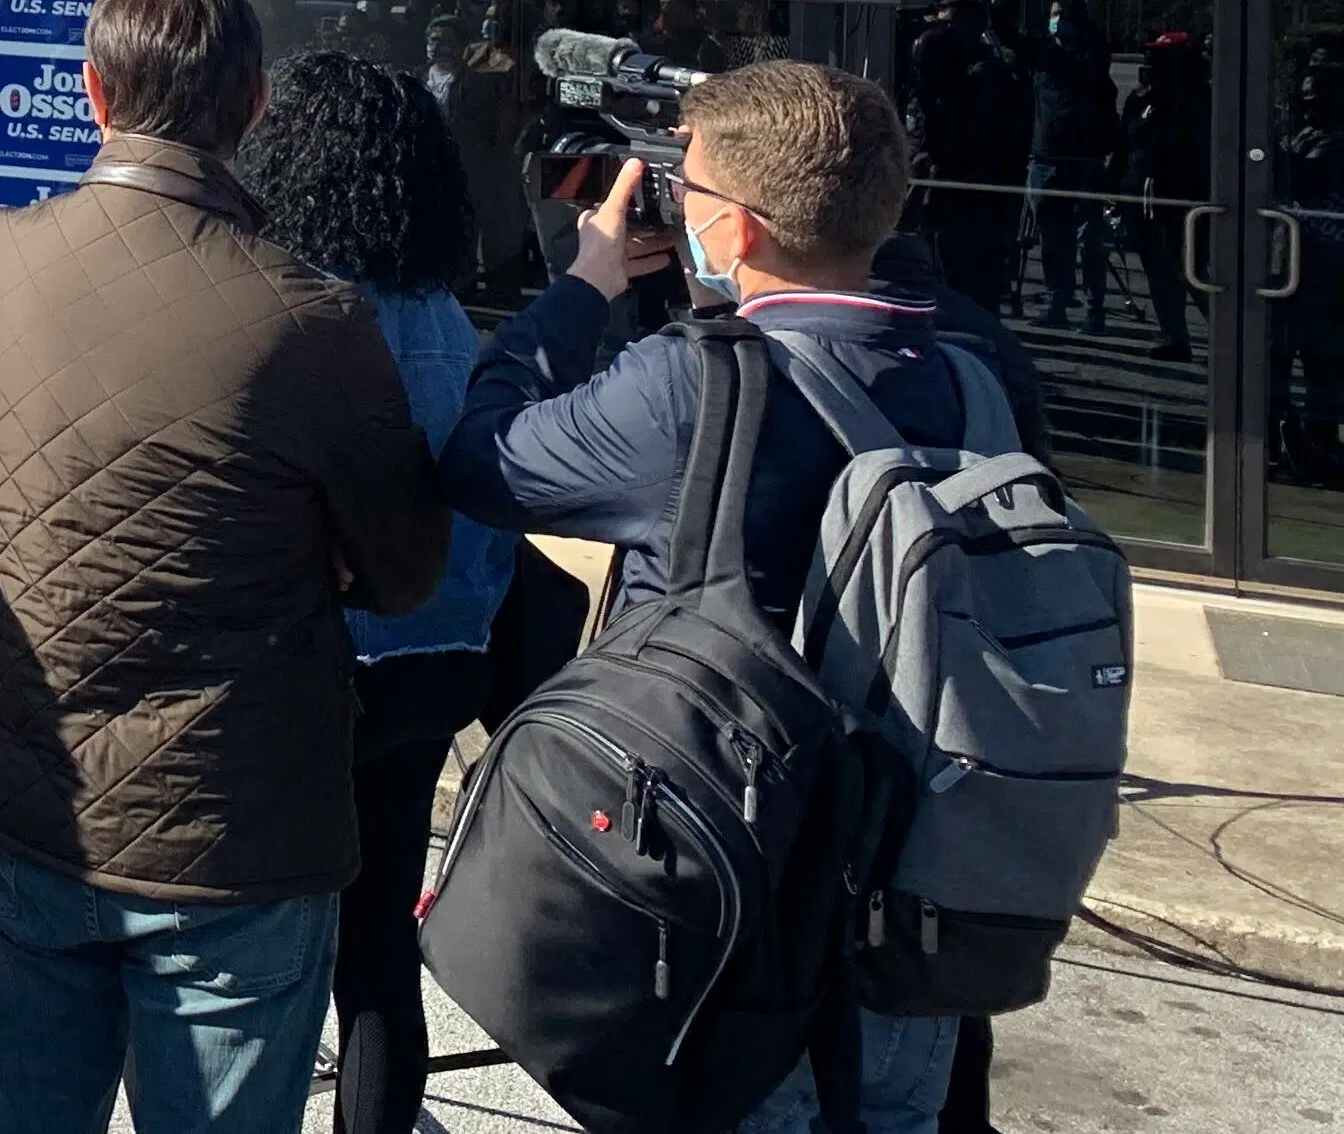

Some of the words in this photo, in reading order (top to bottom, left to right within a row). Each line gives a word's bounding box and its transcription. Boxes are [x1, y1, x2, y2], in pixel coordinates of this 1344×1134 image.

[51, 0, 92, 17] SEN
[0, 83, 95, 122] Osso
[7, 122, 43, 139] U.S.
[48, 125, 102, 144] SENA
